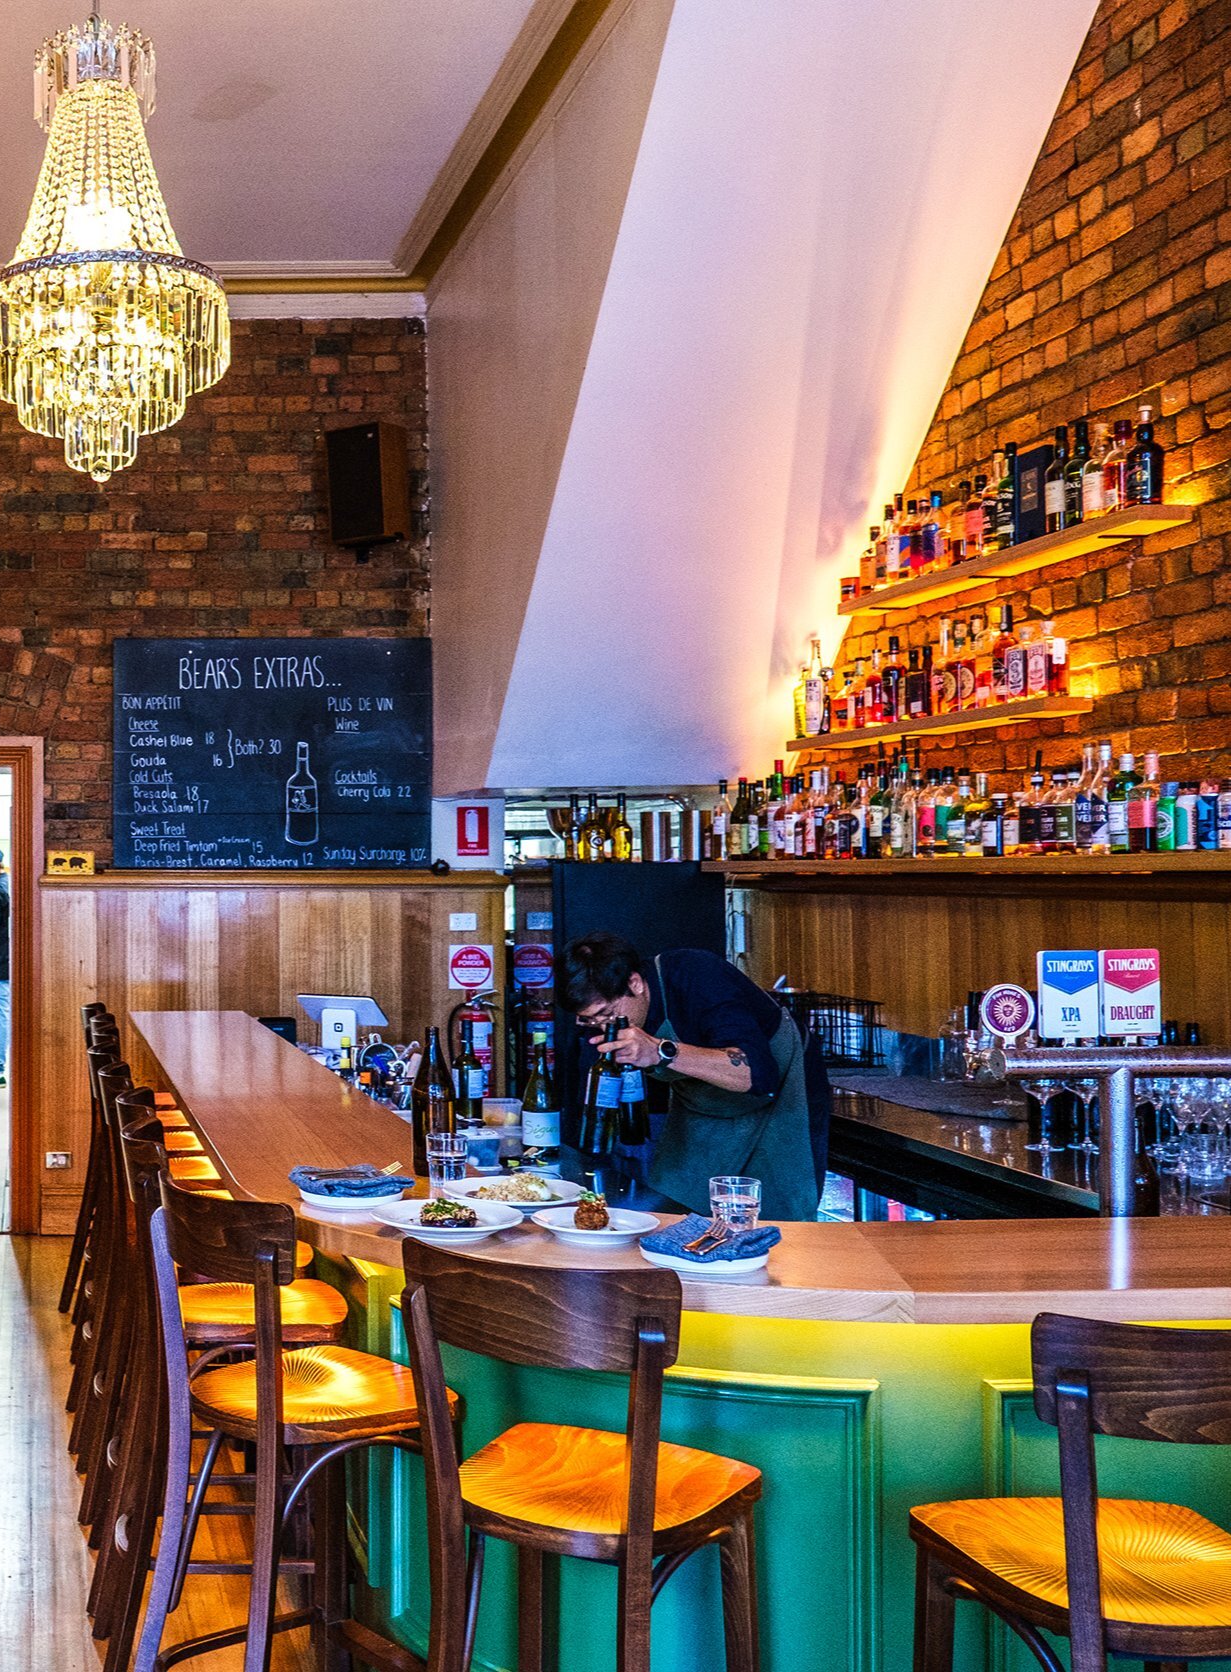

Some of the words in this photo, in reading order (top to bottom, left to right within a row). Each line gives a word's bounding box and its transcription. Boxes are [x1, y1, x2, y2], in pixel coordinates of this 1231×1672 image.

[179, 658, 242, 690] BEAR'S
[122, 697, 142, 710] BON
[328, 697, 352, 712] PLUS
[358, 698, 372, 711] DE
[376, 697, 394, 711] VIN
[128, 716, 159, 731] Cheese
[335, 717, 359, 731] Wine
[129, 734, 167, 747] Cashel
[170, 735, 193, 747] Blue
[205, 731, 215, 745] 18
[235, 739, 264, 756] Both?
[268, 739, 282, 755] 30
[130, 753, 167, 768] Gouda
[213, 754, 223, 767] 16
[129, 769, 148, 783] Cold
[152, 769, 173, 783] Cuts
[335, 769, 377, 783] Cocktails
[133, 785, 178, 799] Bresaola
[186, 785, 200, 801] 18
[337, 786, 369, 802] Cherry
[373, 786, 391, 798] Cola
[397, 786, 412, 798] 22
[134, 800, 158, 813] Duck
[161, 800, 194, 813] Salami
[198, 800, 209, 814] 17
[130, 821, 159, 836] Sweet
[161, 821, 186, 836] Treat
[134, 839, 156, 854] Deep
[159, 839, 180, 852] Fried
[252, 841, 264, 854] 15
[249, 854, 298, 868] Raspberry
[303, 852, 314, 866] 12
[323, 846, 356, 865] Sunday
[359, 846, 406, 865] Surcharge
[1046, 960, 1094, 973] STINGRAYS
[1107, 958, 1156, 971] STINGRAYS
[1061, 1007, 1081, 1022] XPA
[1110, 1005, 1155, 1021] DRAUGHT
